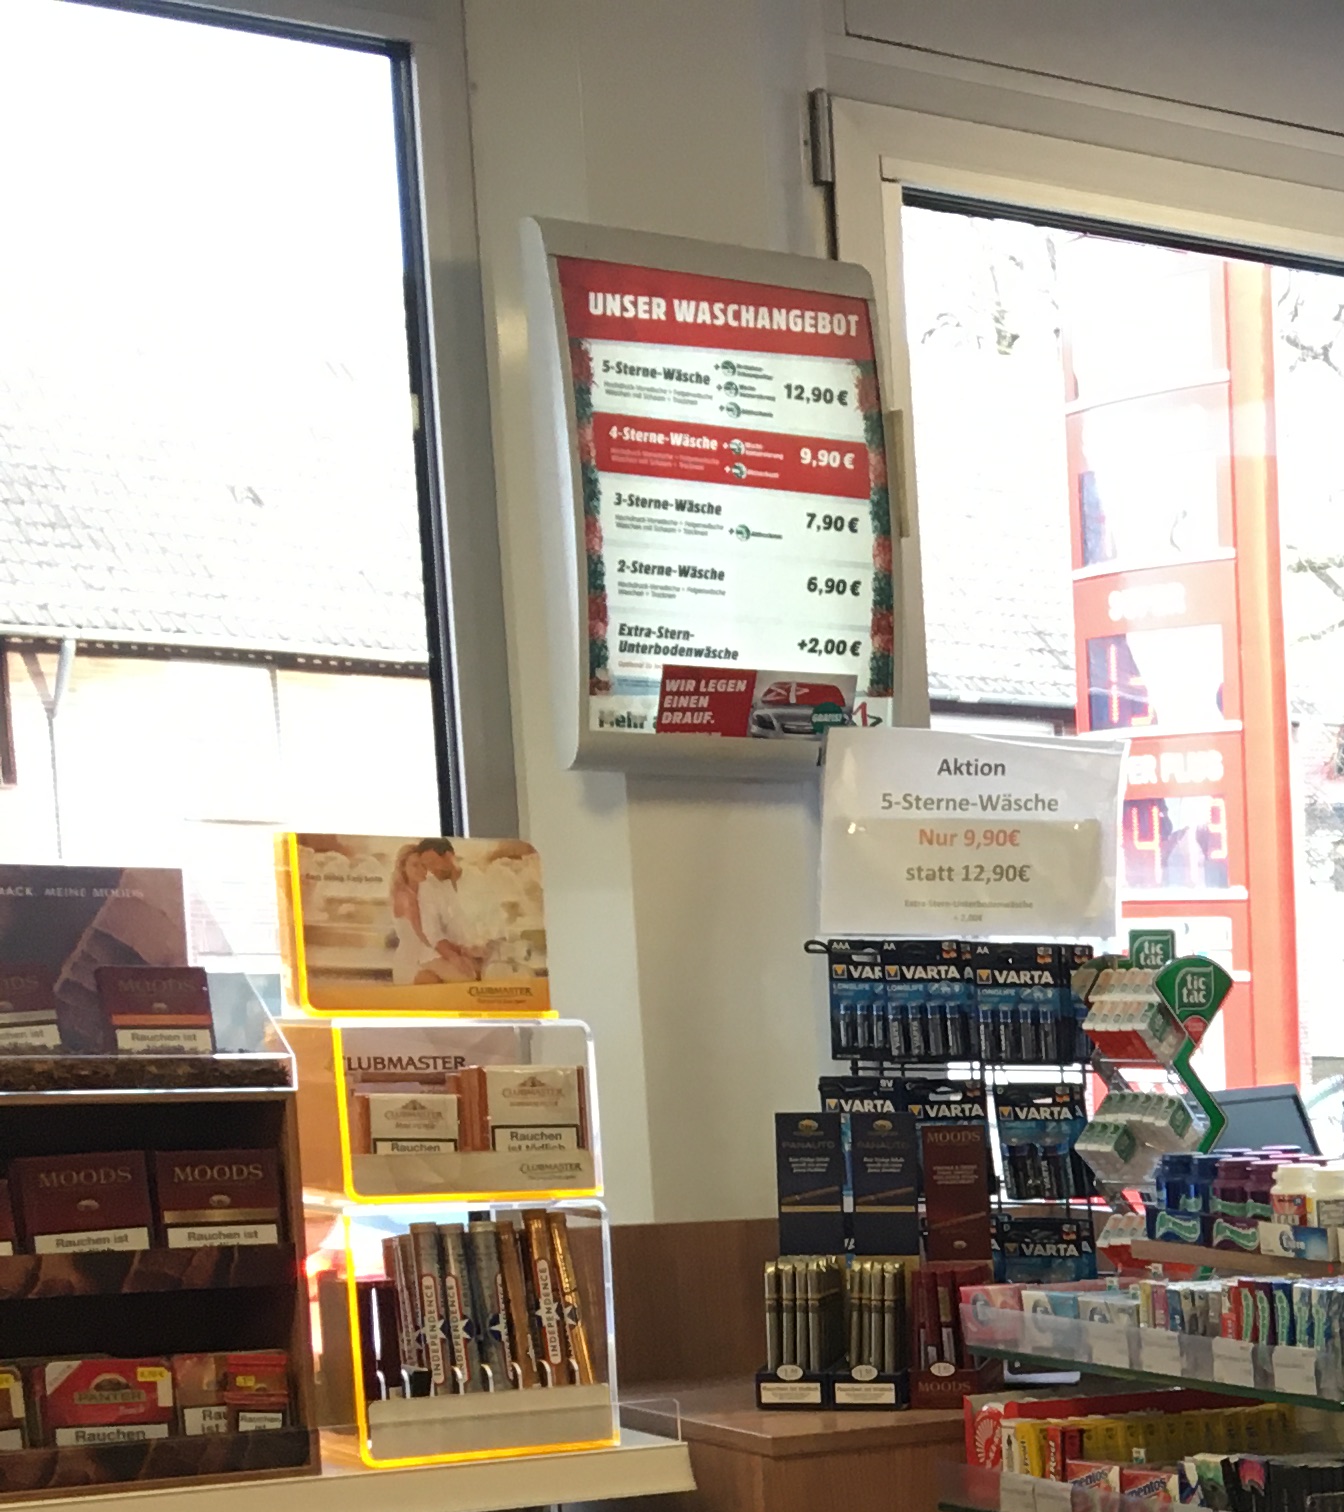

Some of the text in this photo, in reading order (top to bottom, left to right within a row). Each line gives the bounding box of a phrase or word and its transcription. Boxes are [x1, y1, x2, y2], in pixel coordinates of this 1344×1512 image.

[588, 291, 859, 336] UNSER WASCHANGEBOT
[602, 360, 710, 385] 5-Sterne-Wäsche
[784, 383, 848, 406] 12,90 €
[609, 426, 718, 450] 4-Sterne-Wäsche
[800, 448, 840, 468] 9,90
[843, 453, 854, 469] €
[614, 492, 722, 517] 3-Sterne-Wäsche
[806, 513, 859, 534] 7,90 €
[617, 559, 725, 582] 2-Sterne-Wäsche
[806, 576, 861, 597] 6,90 €
[618, 623, 694, 641] Extra-Stern-
[618, 640, 739, 660] Unterbodenwäsche
[798, 638, 862, 657] +2,00 €
[665, 679, 747, 693] WIR LEGEN
[663, 695, 708, 708] EINEN
[662, 712, 715, 724] DRAUF.
[937, 758, 1006, 777] Aktion
[880, 792, 1059, 812] 5-Sterne-Wäsche
[919, 829, 1020, 850] Nur 9,90€
[905, 864, 1031, 884] statt 12,90€
[901, 964, 961, 981] VARTA
[993, 968, 1054, 986] VARTA
[1184, 972, 1207, 989] tic
[468, 987, 533, 997] CLUBMASTER
[1181, 988, 1207, 1005] tac
[839, 1098, 896, 1114] VARTA
[924, 1102, 985, 1119] VARTA
[1015, 1105, 1074, 1122] VARTA
[510, 1131, 562, 1141] Rauchen
[927, 1130, 981, 1144] MOODS
[173, 1164, 264, 1183] MOODS
[520, 1162, 582, 1174] CLUBMASTER
[40, 1167, 132, 1188] MOODS
[56, 1236, 110, 1247] Rauchen
[188, 1230, 240, 1240] Rauchen
[1020, 1242, 1080, 1258] VARTA
[539, 1266, 558, 1358] INDEPENDENCE
[425, 1283, 442, 1376] INDEPENDENCE
[917, 1380, 972, 1393] MOODS
[75, 1430, 146, 1442] Rauchen
